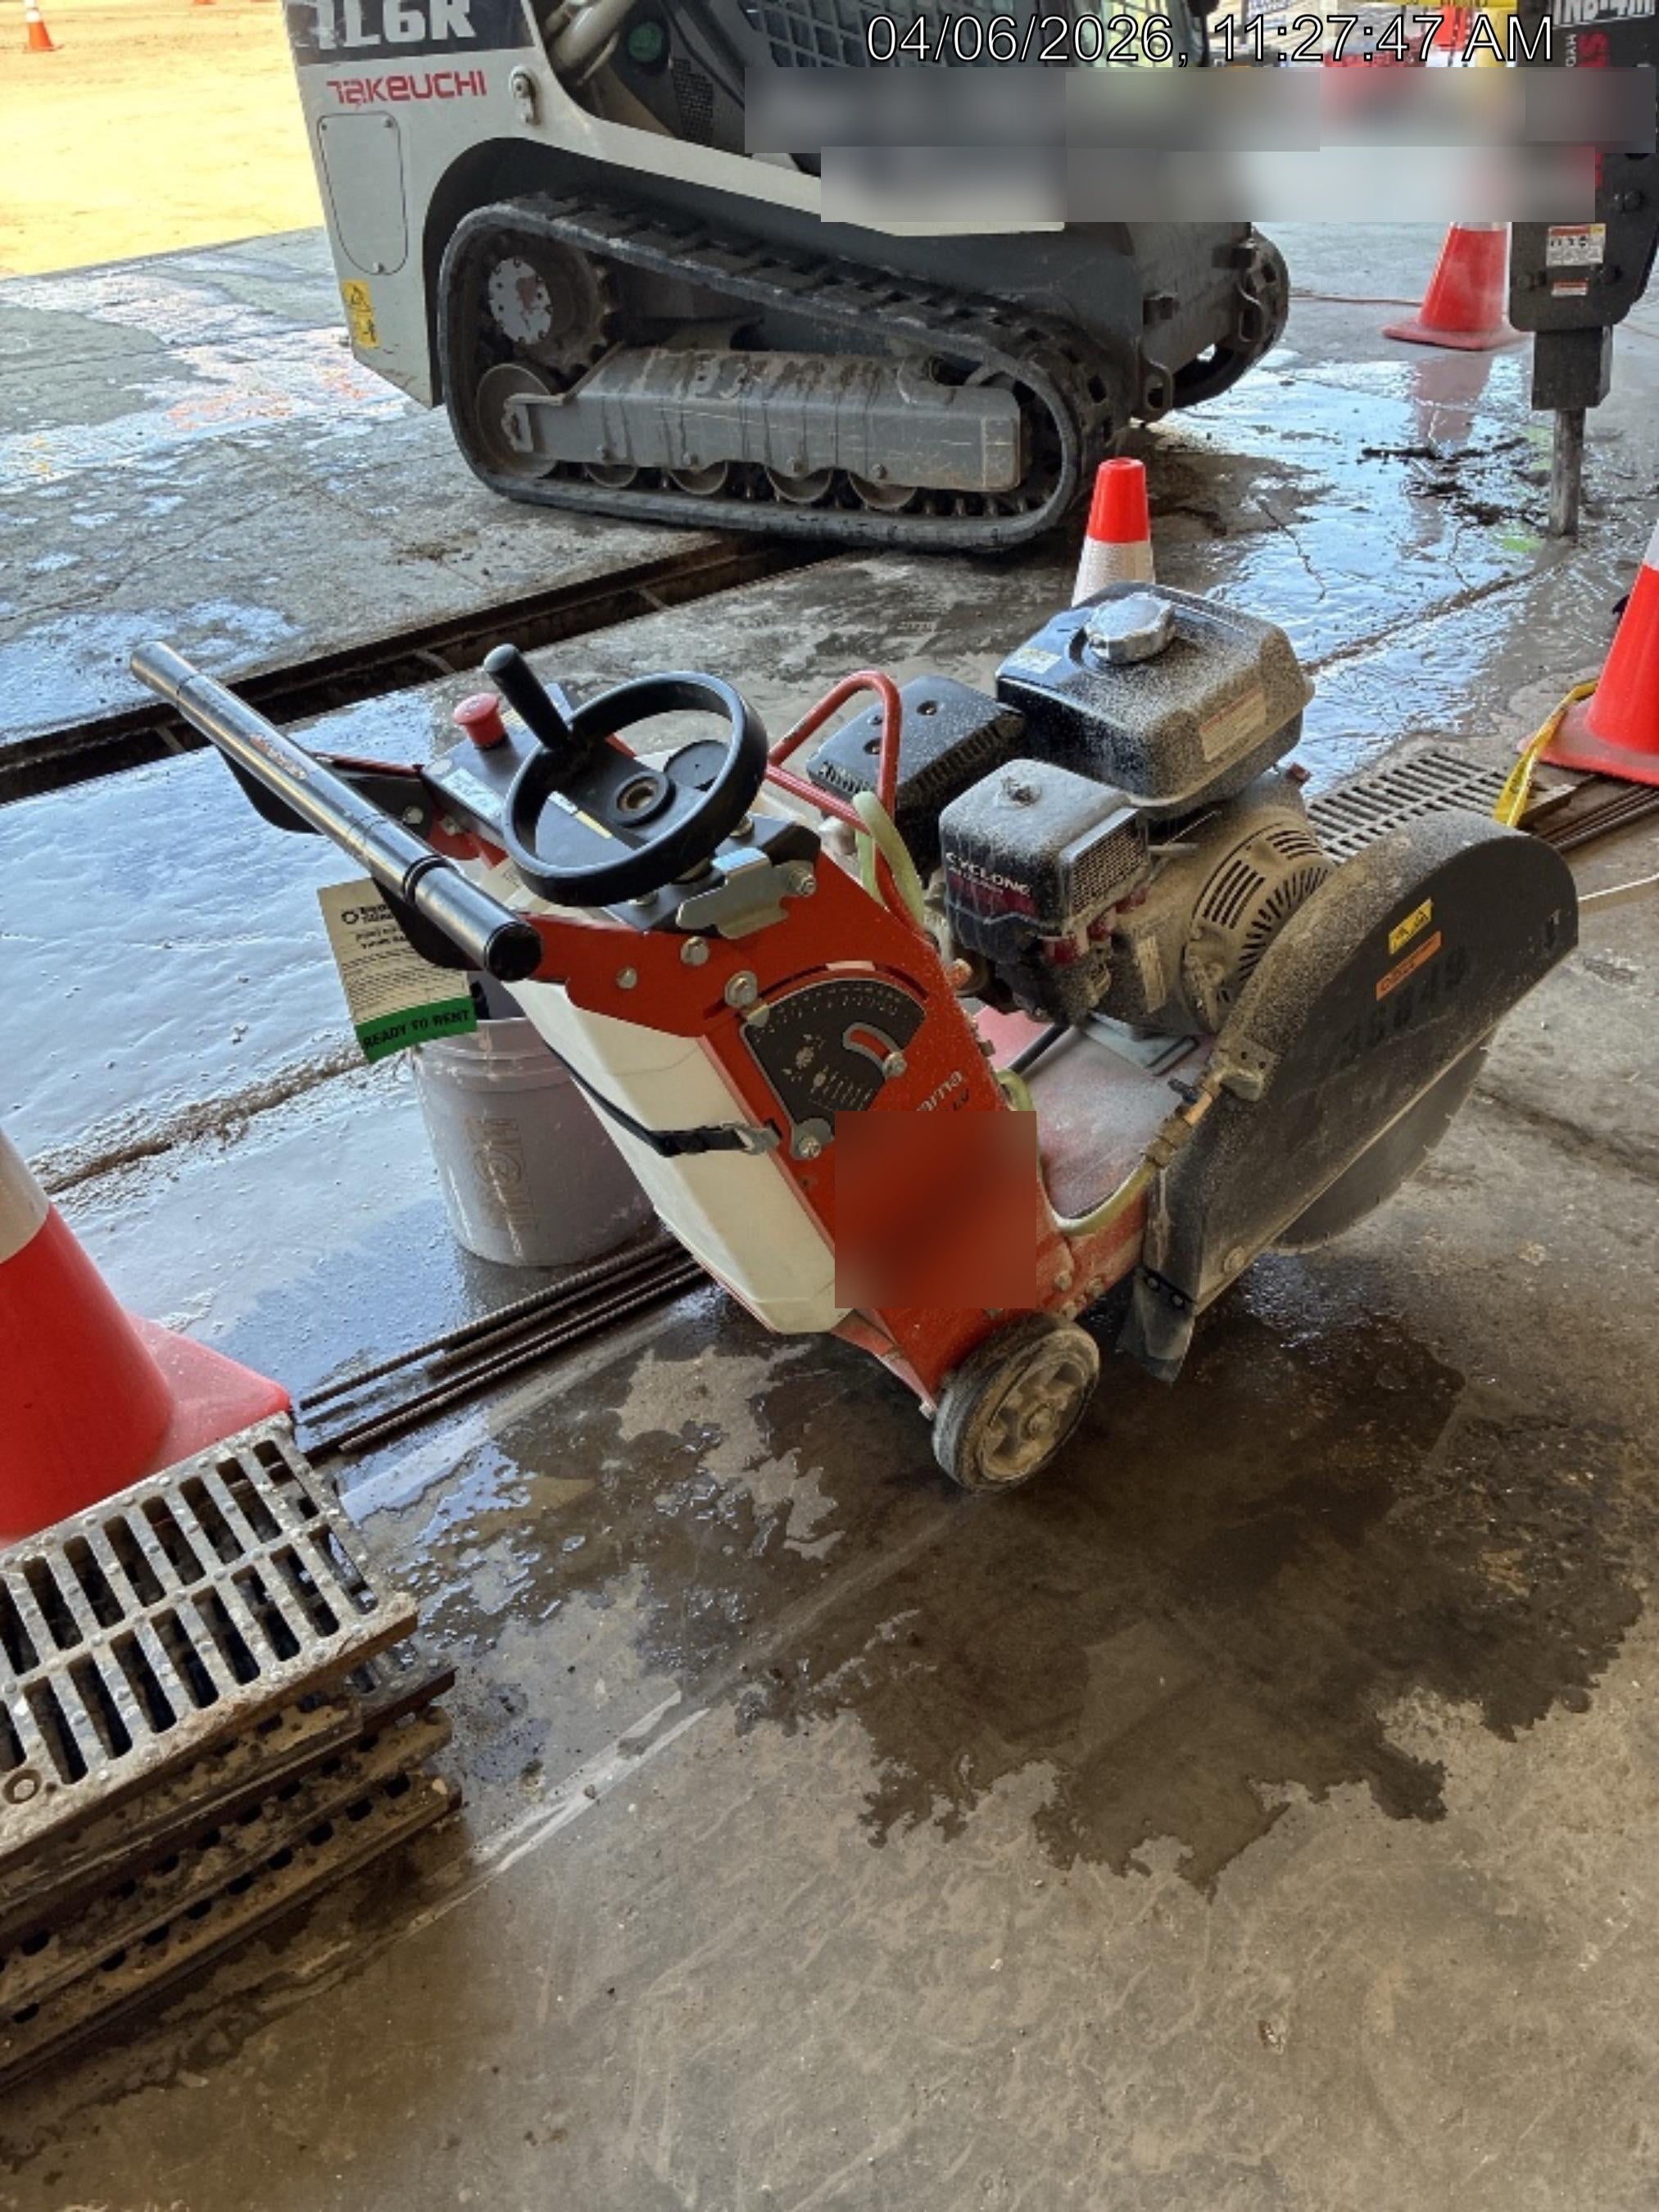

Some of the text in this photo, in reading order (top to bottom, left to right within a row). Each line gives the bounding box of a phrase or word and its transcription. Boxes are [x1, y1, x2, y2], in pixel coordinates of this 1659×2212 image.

[363, 1009, 469, 1050] READY TO RENT
